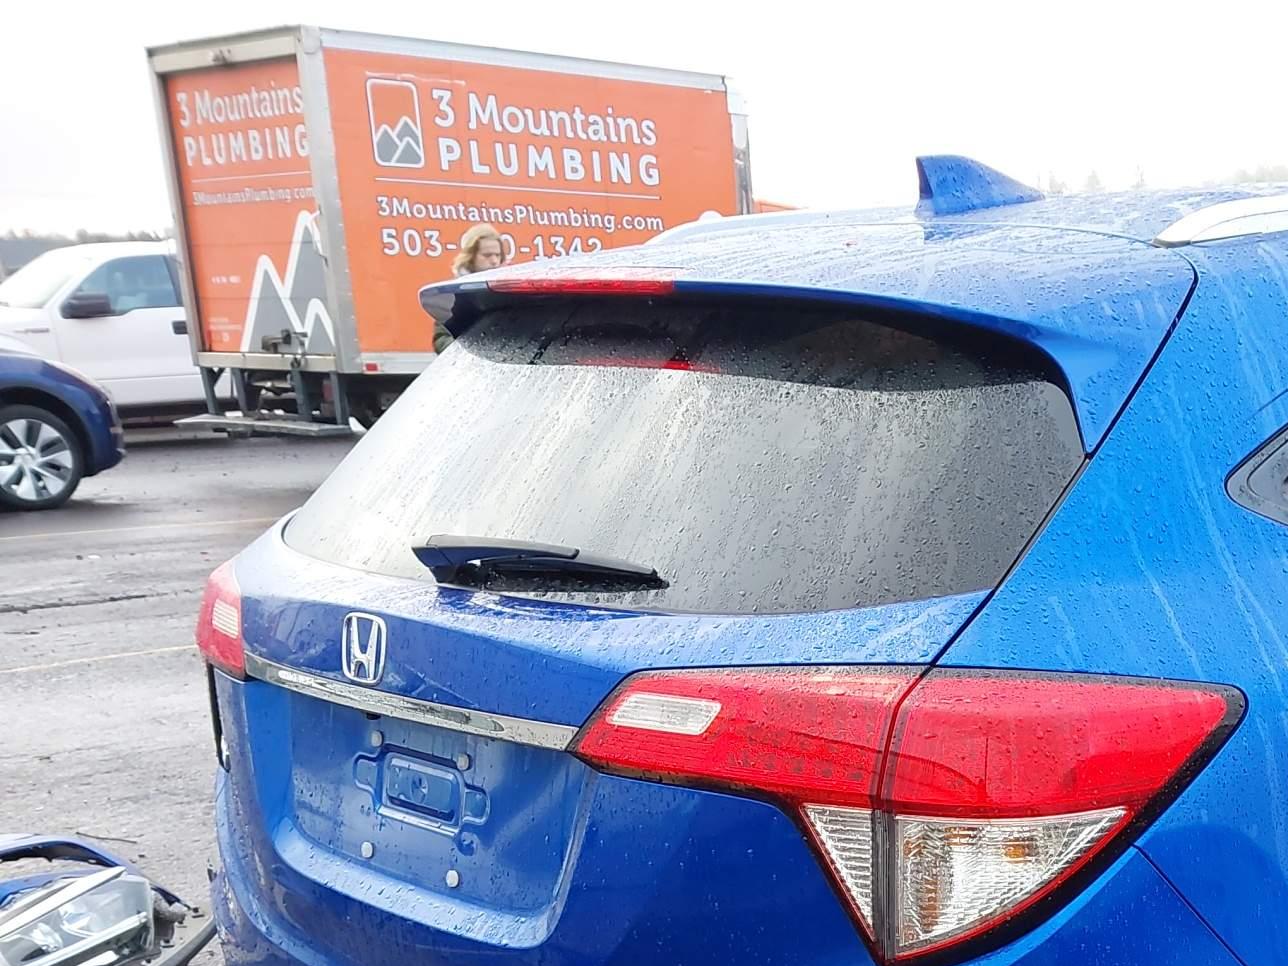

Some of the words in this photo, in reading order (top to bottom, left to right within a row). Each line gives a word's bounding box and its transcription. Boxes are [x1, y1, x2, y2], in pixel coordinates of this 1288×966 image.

[176, 92, 190, 128] 3
[194, 80, 305, 126] Mountains
[432, 88, 455, 128] 3
[467, 92, 658, 146] Mountains
[183, 124, 310, 167] PLUMBING
[437, 137, 661, 187] PLUMBING
[376, 196, 664, 232] 3MountainsPlumbing.com
